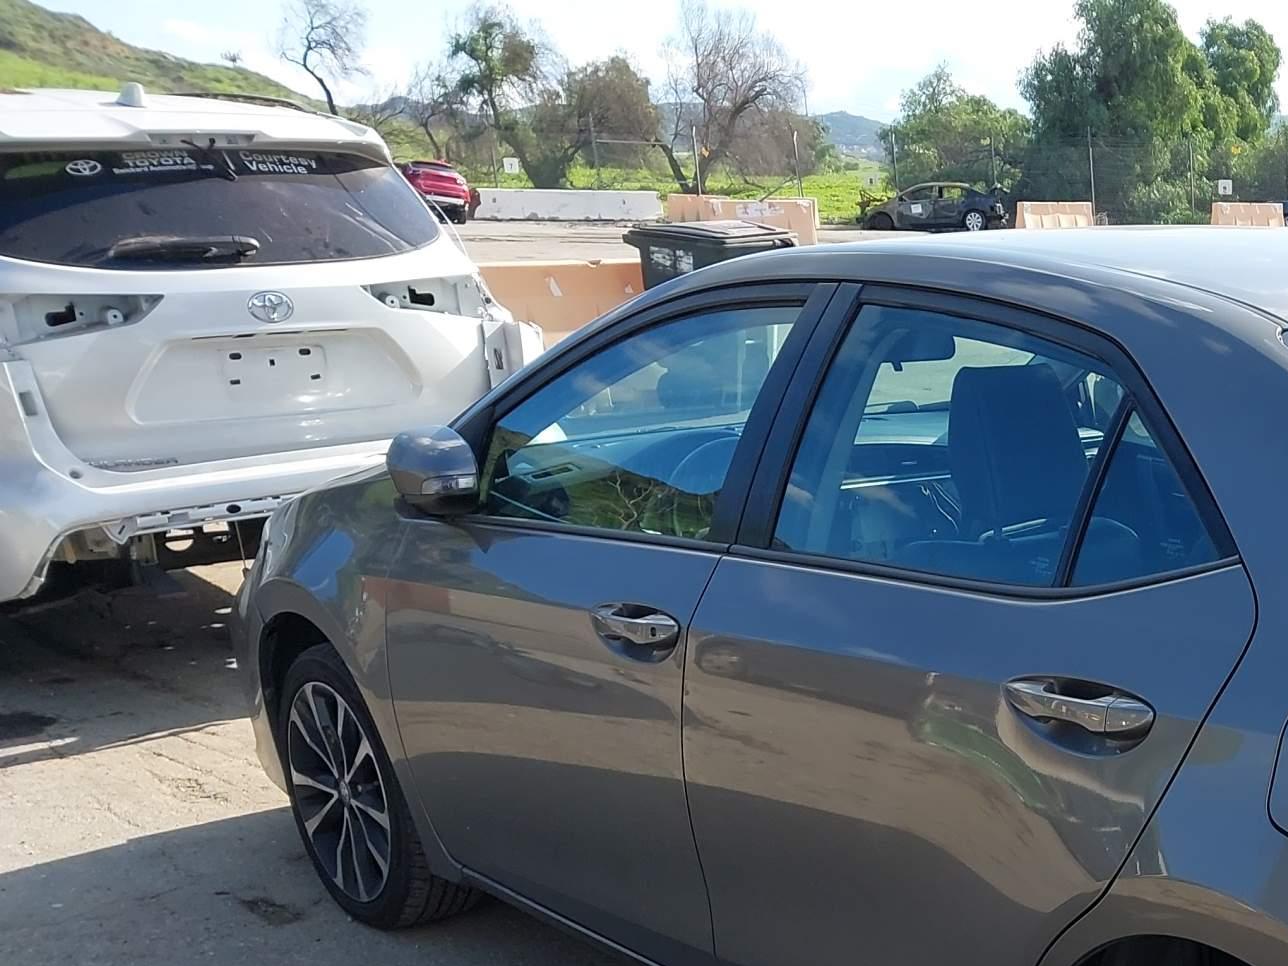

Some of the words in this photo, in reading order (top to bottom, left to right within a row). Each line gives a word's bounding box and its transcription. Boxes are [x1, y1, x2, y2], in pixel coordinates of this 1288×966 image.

[122, 150, 188, 160] CROWN
[240, 150, 317, 169] Courtesy
[123, 157, 196, 167] TOYOTA
[244, 160, 308, 173] Vehicle
